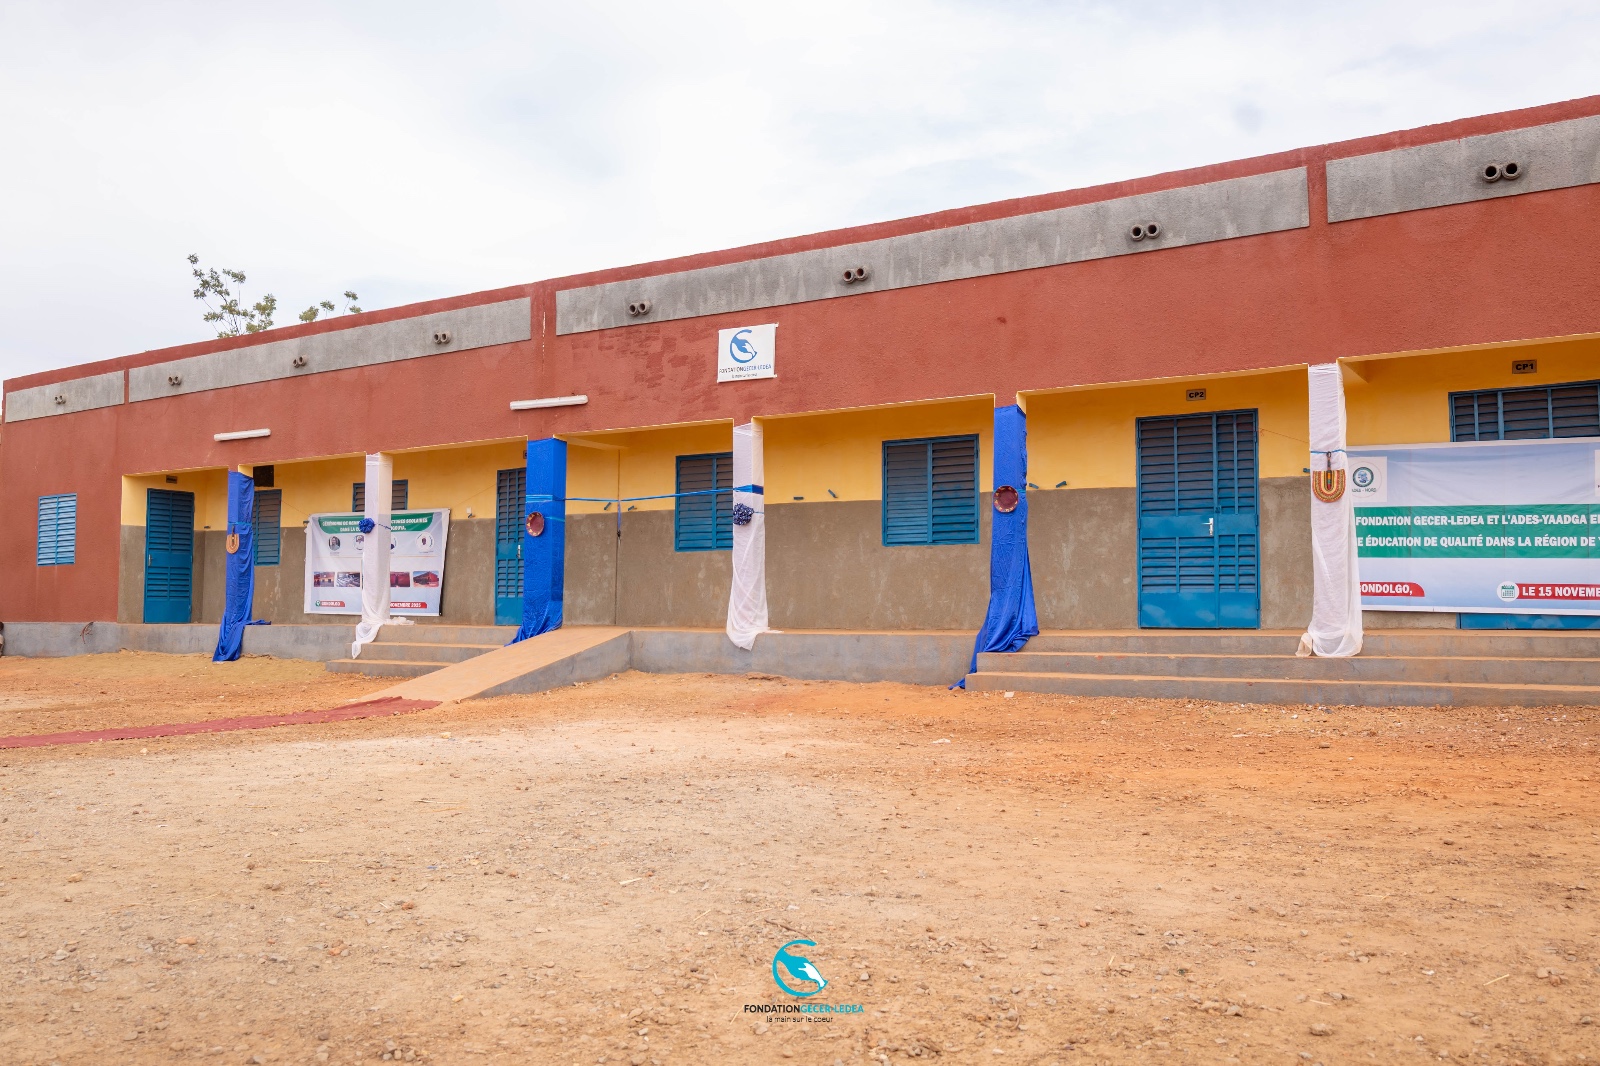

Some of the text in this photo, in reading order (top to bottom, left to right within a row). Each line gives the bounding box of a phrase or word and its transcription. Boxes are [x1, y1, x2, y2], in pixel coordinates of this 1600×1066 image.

[1355, 514, 1600, 526] FONDATION GECER-LEDEA ET L'ADES-YAADGA E
[1365, 534, 1421, 547] ÉDUCATION
[1423, 537, 1438, 547] DE
[1440, 534, 1483, 548] QUALITÉ
[1485, 537, 1515, 547] DANS
[1518, 537, 1532, 547] LA
[1534, 534, 1578, 547] RÉGION
[1580, 536, 1596, 547] DE
[1522, 586, 1536, 596] LE
[1538, 586, 1553, 597] 15
